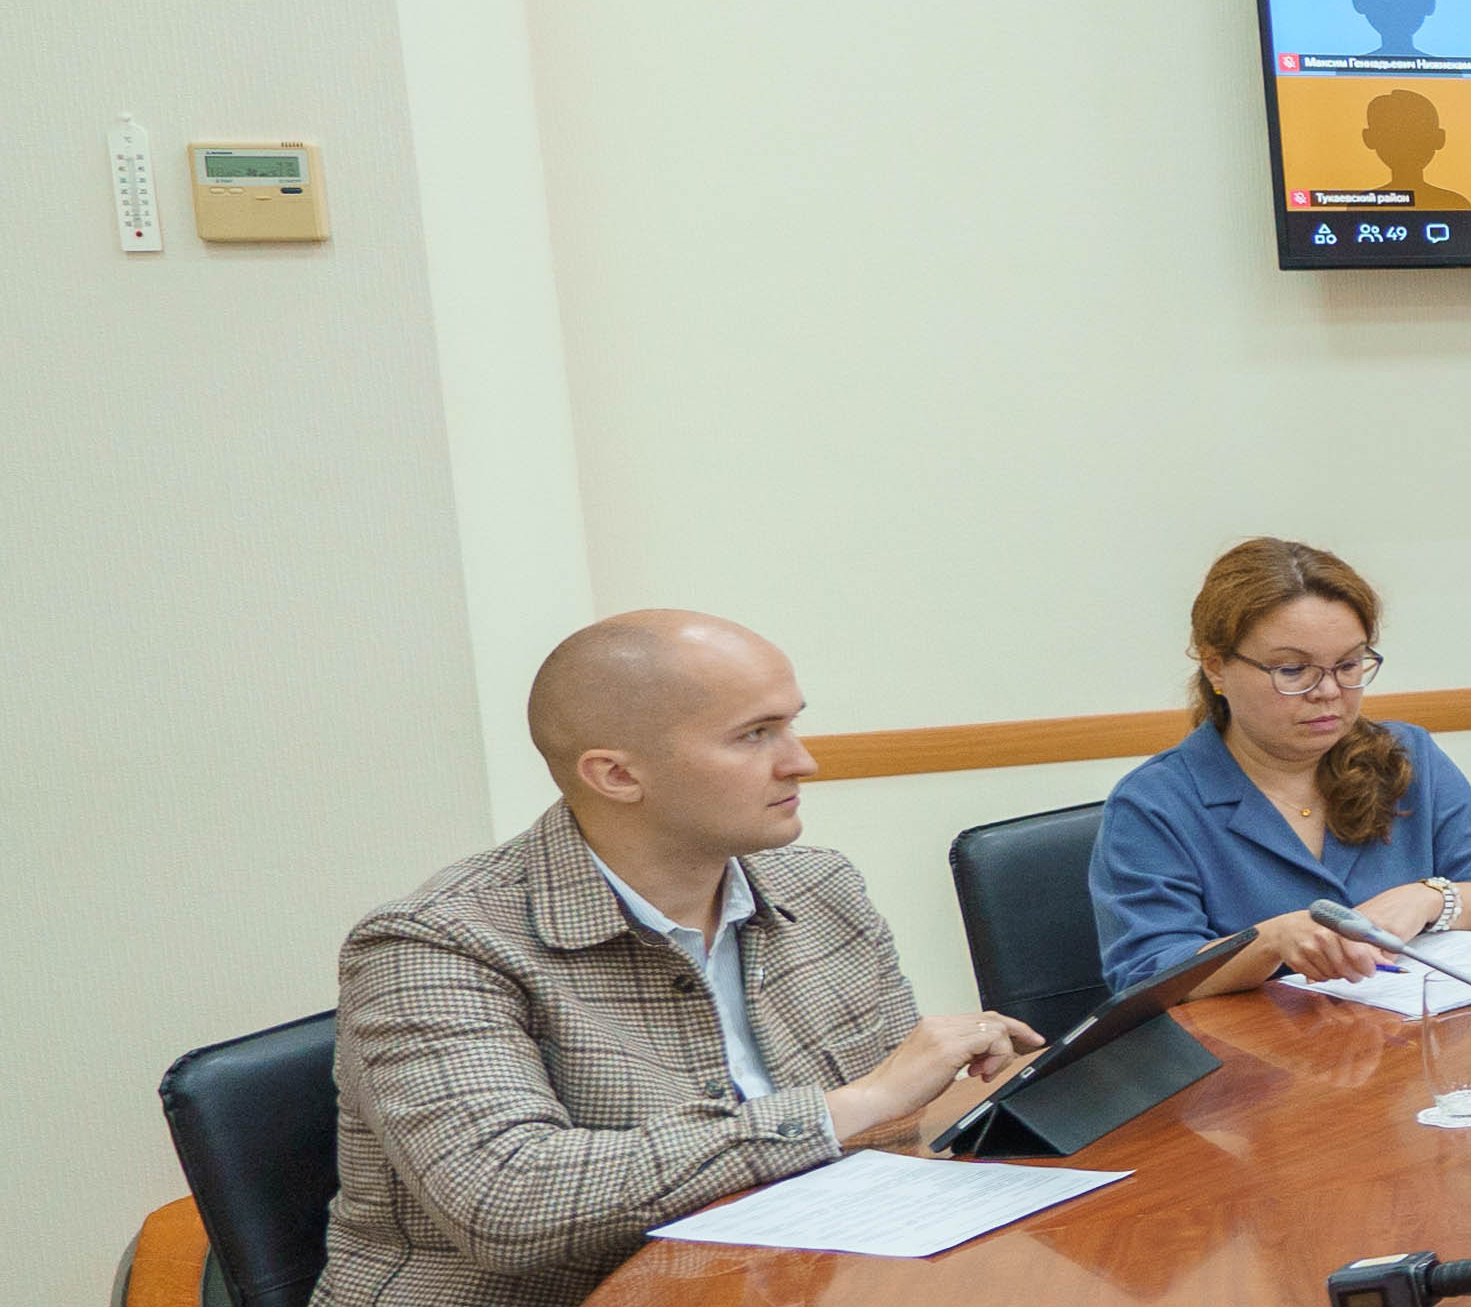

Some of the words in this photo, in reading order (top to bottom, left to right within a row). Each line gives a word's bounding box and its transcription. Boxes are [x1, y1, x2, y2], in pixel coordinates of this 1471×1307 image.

[1304, 57, 1347, 68] Максим
[1315, 192, 1376, 205] Тукаевский
[1377, 193, 1410, 205] район
[1386, 226, 1408, 241] 49
